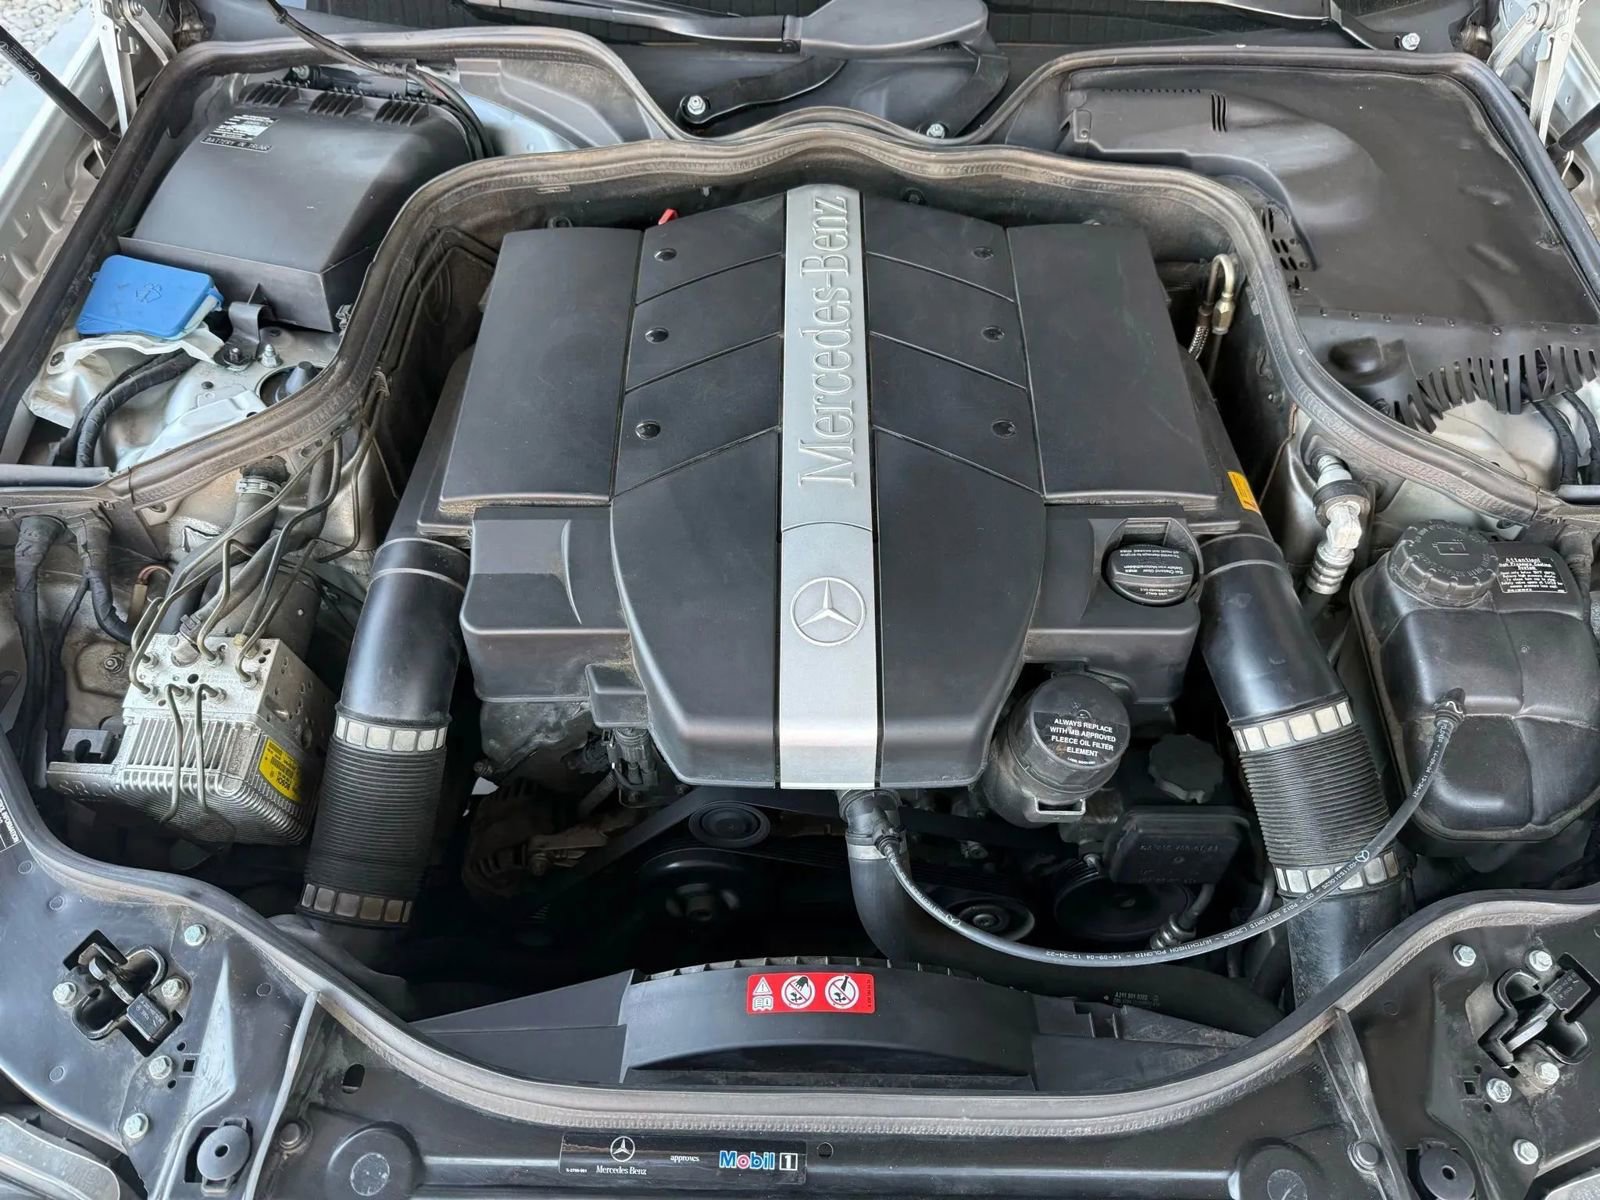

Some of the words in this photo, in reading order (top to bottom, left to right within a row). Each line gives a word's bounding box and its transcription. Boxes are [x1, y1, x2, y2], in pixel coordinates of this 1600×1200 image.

[798, 195, 855, 488] Mercedes-Benz
[1054, 718, 1082, 728] ALWAYS
[1083, 722, 1113, 733] REPLACE
[1049, 726, 1067, 734] WITH
[1081, 731, 1116, 742] APPROVED
[1051, 735, 1078, 744] FLEECE
[1092, 741, 1114, 751] FILTER
[1066, 746, 1098, 757] ELEMENT
[1169, 938, 1213, 955] HUTCHINSON
[670, 1153, 699, 1163] approves
[718, 1150, 775, 1170] Mobil
[596, 1165, 629, 1175] Mercedes
[629, 1167, 647, 1176] Benz
